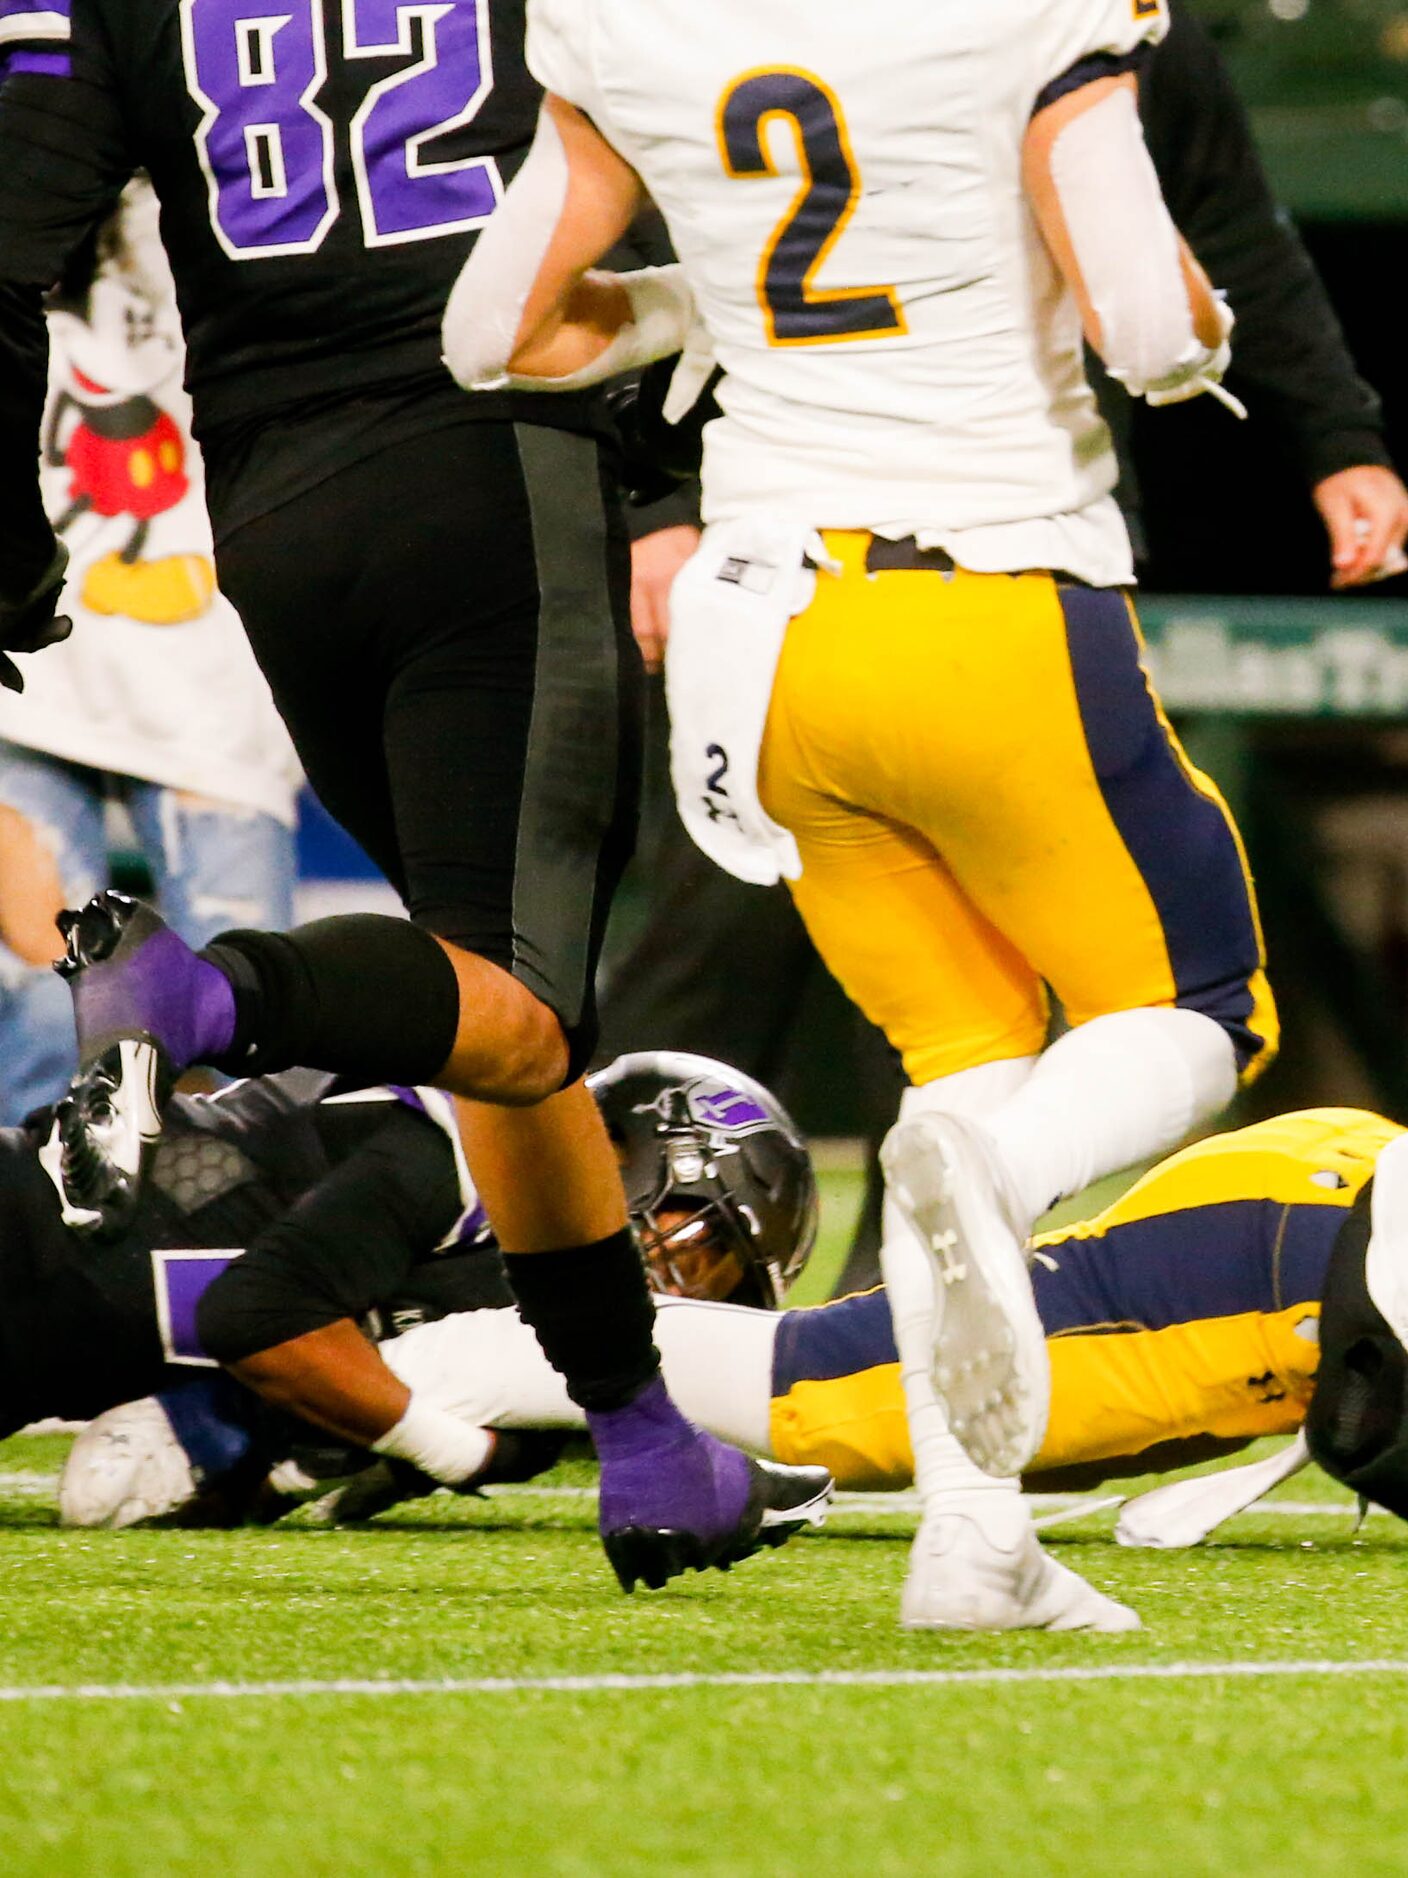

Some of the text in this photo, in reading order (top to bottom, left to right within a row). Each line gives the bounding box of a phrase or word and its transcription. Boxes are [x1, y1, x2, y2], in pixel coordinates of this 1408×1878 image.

[179, 0, 505, 260] 82
[714, 63, 908, 347] 2
[706, 743, 729, 797] 2
